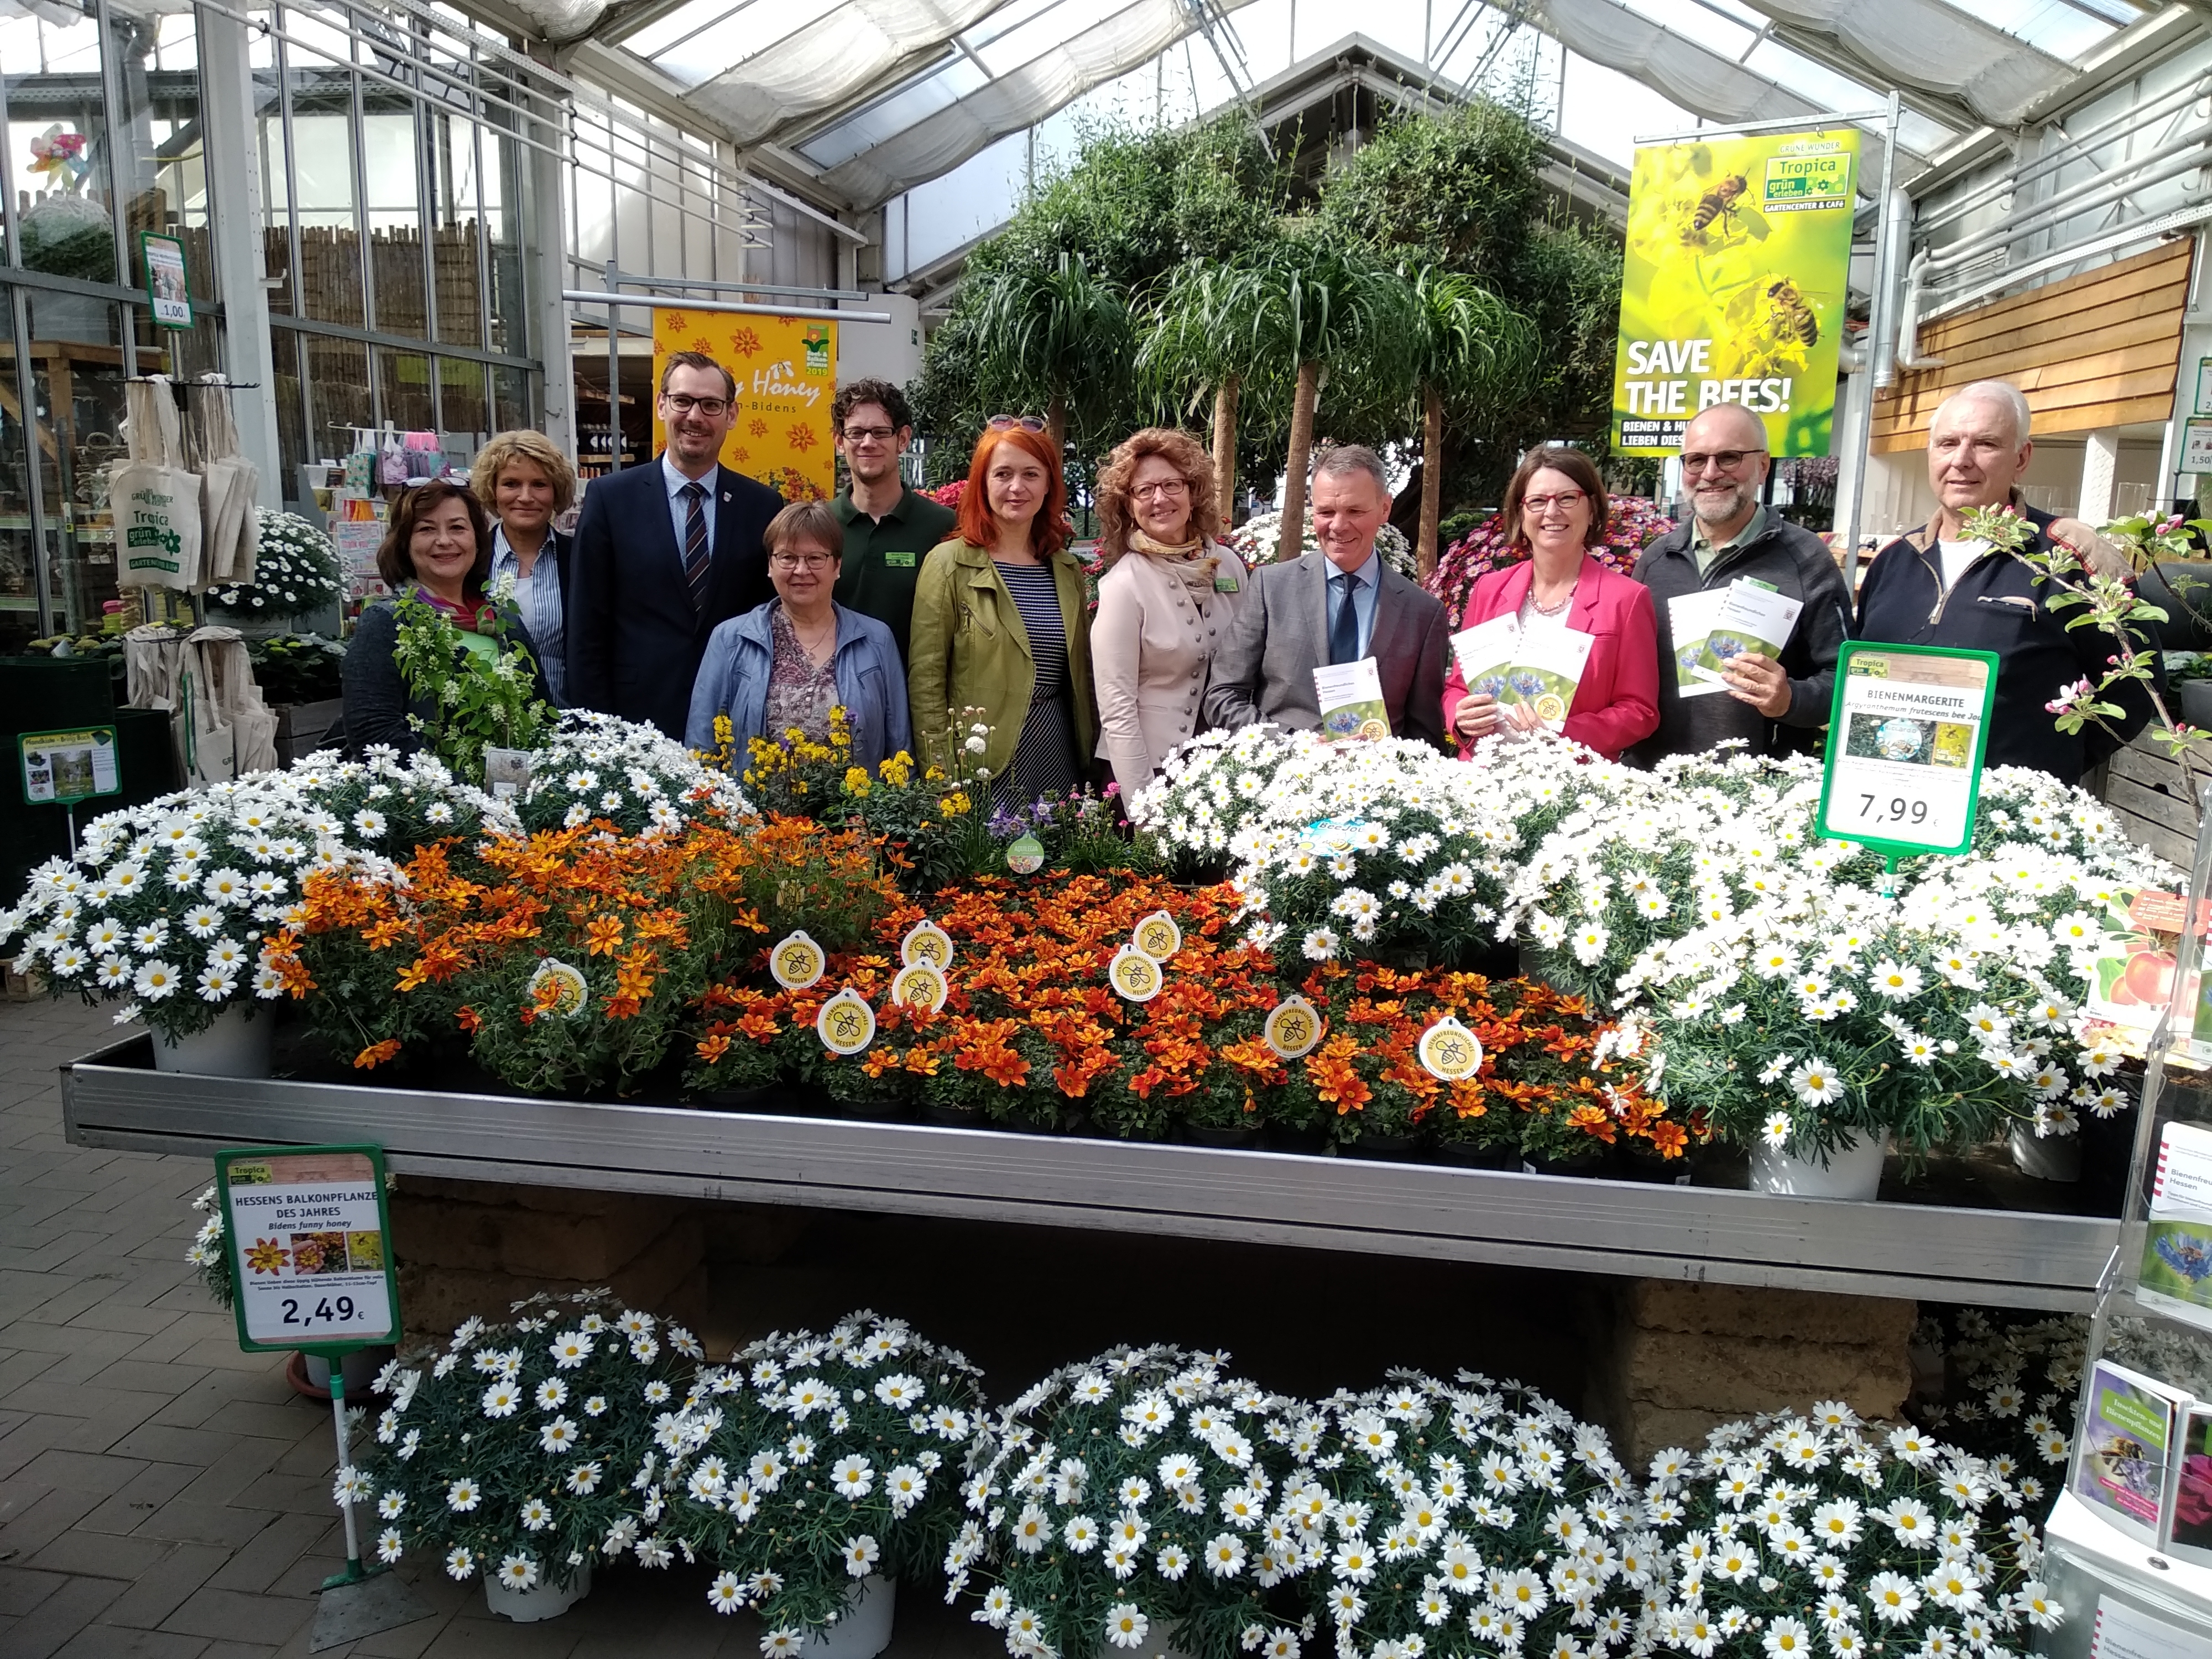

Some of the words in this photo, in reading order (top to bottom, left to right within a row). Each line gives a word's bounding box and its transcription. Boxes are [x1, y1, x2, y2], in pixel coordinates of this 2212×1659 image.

[1780, 144, 1805, 153] GRÜNE
[1808, 142, 1840, 150] WUNDER
[1780, 158, 1836, 176] Tropica
[1769, 180, 1795, 192] grün
[1773, 189, 1803, 197] erleben
[1765, 202, 1817, 212] GARTENCENTER
[164, 305, 184, 317] 1,00
[1626, 339, 1712, 375] SAVE
[807, 367, 827, 375] 2019
[753, 369, 821, 407] Honey
[1625, 380, 1688, 414] THE
[1699, 378, 1792, 413] BEES!
[1623, 421, 1661, 432] BIENEN
[1663, 421, 1672, 432] &
[1622, 435, 1658, 446] LIEBEN
[129, 528, 151, 541] grün
[1856, 659, 1884, 667] Tropica
[1867, 690, 1965, 708] BIENENMARGERITE
[1845, 701, 1907, 712] Argyranthemum
[1908, 707, 1949, 718] frutescens
[1952, 711, 1966, 719] bee
[1885, 725, 1917, 733] Riccardo
[1860, 794, 1928, 824] 7,99
[1141, 921, 1176, 943] BIENENFREUNDLICHES
[908, 932, 947, 952] BIENENFREUNDLICHES
[778, 943, 818, 963] BIENENFREUNDLICHES
[1145, 950, 1162, 958] HESSEN
[1117, 956, 1154, 977] BIENENFREUNDLICHES
[901, 970, 941, 993] BIENENFREUNDLICHES
[1133, 987, 1152, 995] HESSEN
[826, 1002, 869, 1026] BIENENFREUNDLICHES
[1273, 1009, 1314, 1029] BIENENFREUNDLICHES
[835, 1039, 856, 1047] HESSEN
[1428, 1031, 1475, 1052] BIENENFREUNDLICHES
[234, 1166, 264, 1175] Tropica
[2169, 1177, 2198, 1191] Hessen
[236, 1196, 283, 1206] HESSENS
[287, 1192, 378, 1204] BALKONPFLANZE
[276, 1209, 296, 1218] DES
[300, 1207, 341, 1217] JAHRES
[299, 1221, 323, 1230] funny
[326, 1220, 352, 1229] honey
[281, 1296, 354, 1327] 2,49
[357, 1311, 365, 1319] €
[2114, 1399, 2148, 1422] Insekten-
[2149, 1418, 2163, 1430] und
[2106, 1406, 2161, 1441] Bienenpflanzen
